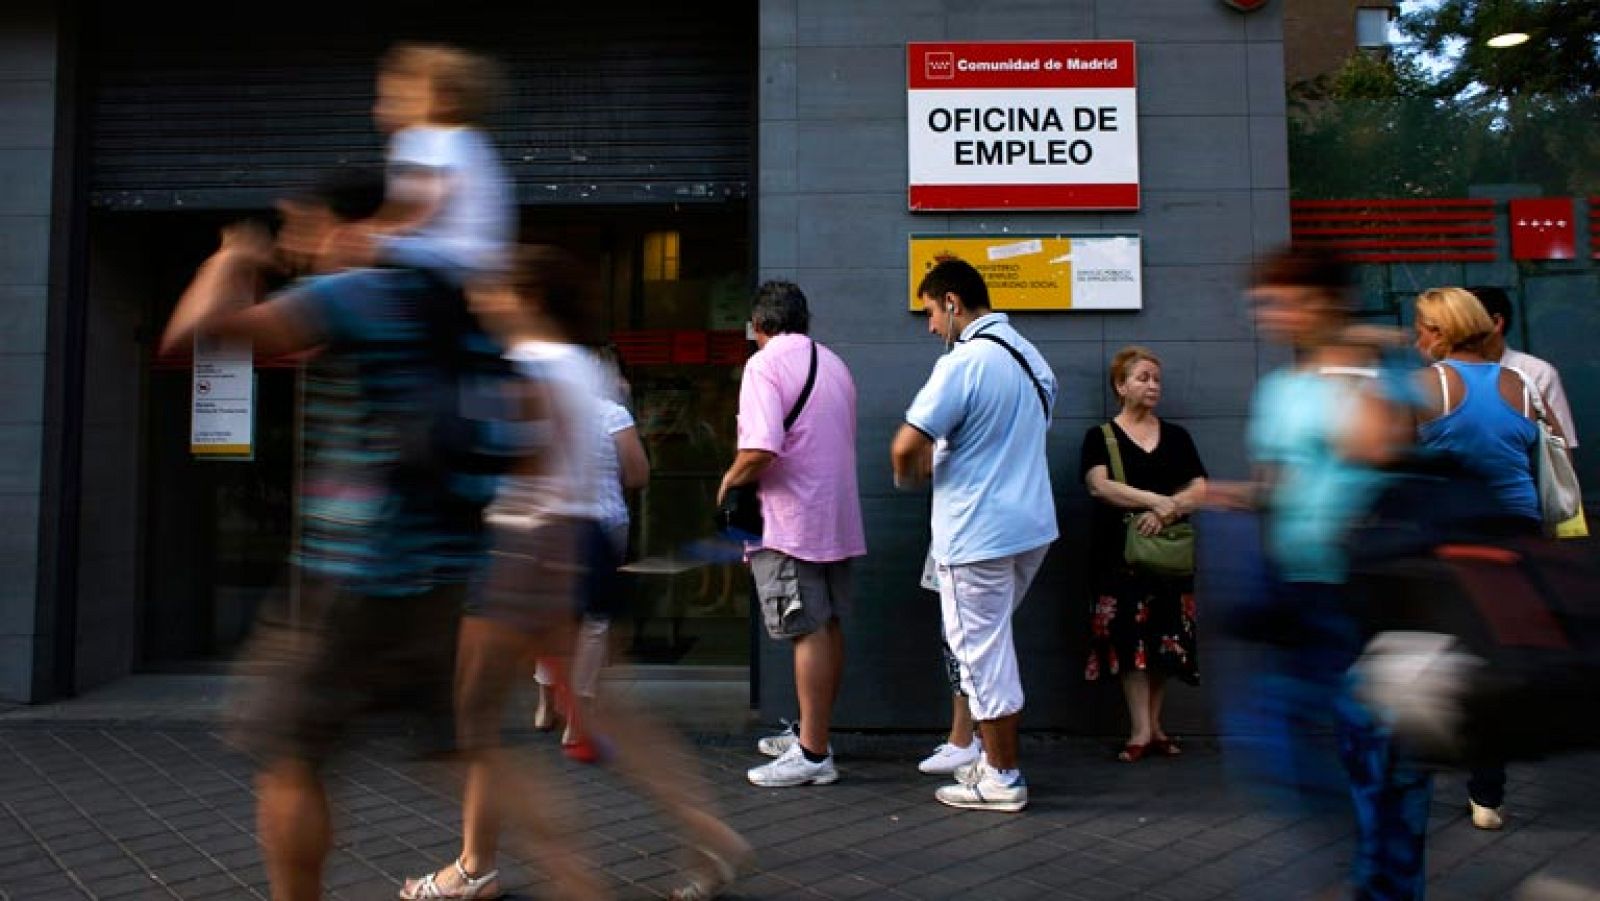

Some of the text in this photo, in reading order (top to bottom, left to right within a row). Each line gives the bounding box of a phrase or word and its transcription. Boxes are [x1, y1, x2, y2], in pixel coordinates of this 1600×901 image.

[957, 58, 1118, 71] Comunidad de Madrid
[928, 107, 1118, 132] OFICINA DE
[955, 139, 1093, 165] EMPLEO
